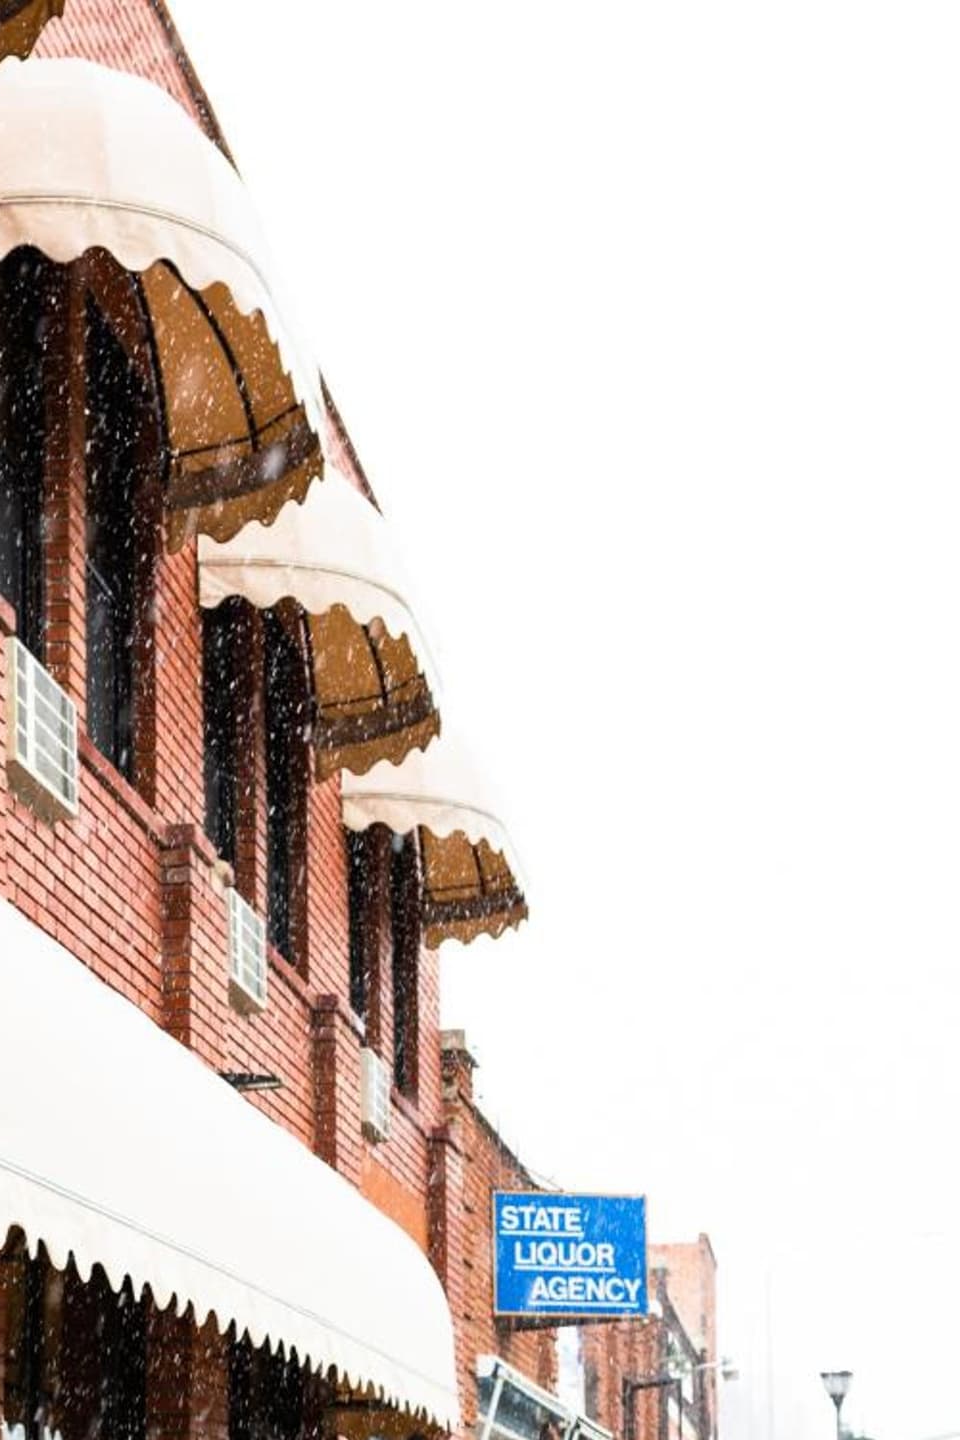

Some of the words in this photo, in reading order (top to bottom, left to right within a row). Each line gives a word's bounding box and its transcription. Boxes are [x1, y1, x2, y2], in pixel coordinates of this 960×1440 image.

[501, 1206, 582, 1231] STATE
[514, 1242, 615, 1266] LIQUOR
[531, 1276, 641, 1301] AGENCY
